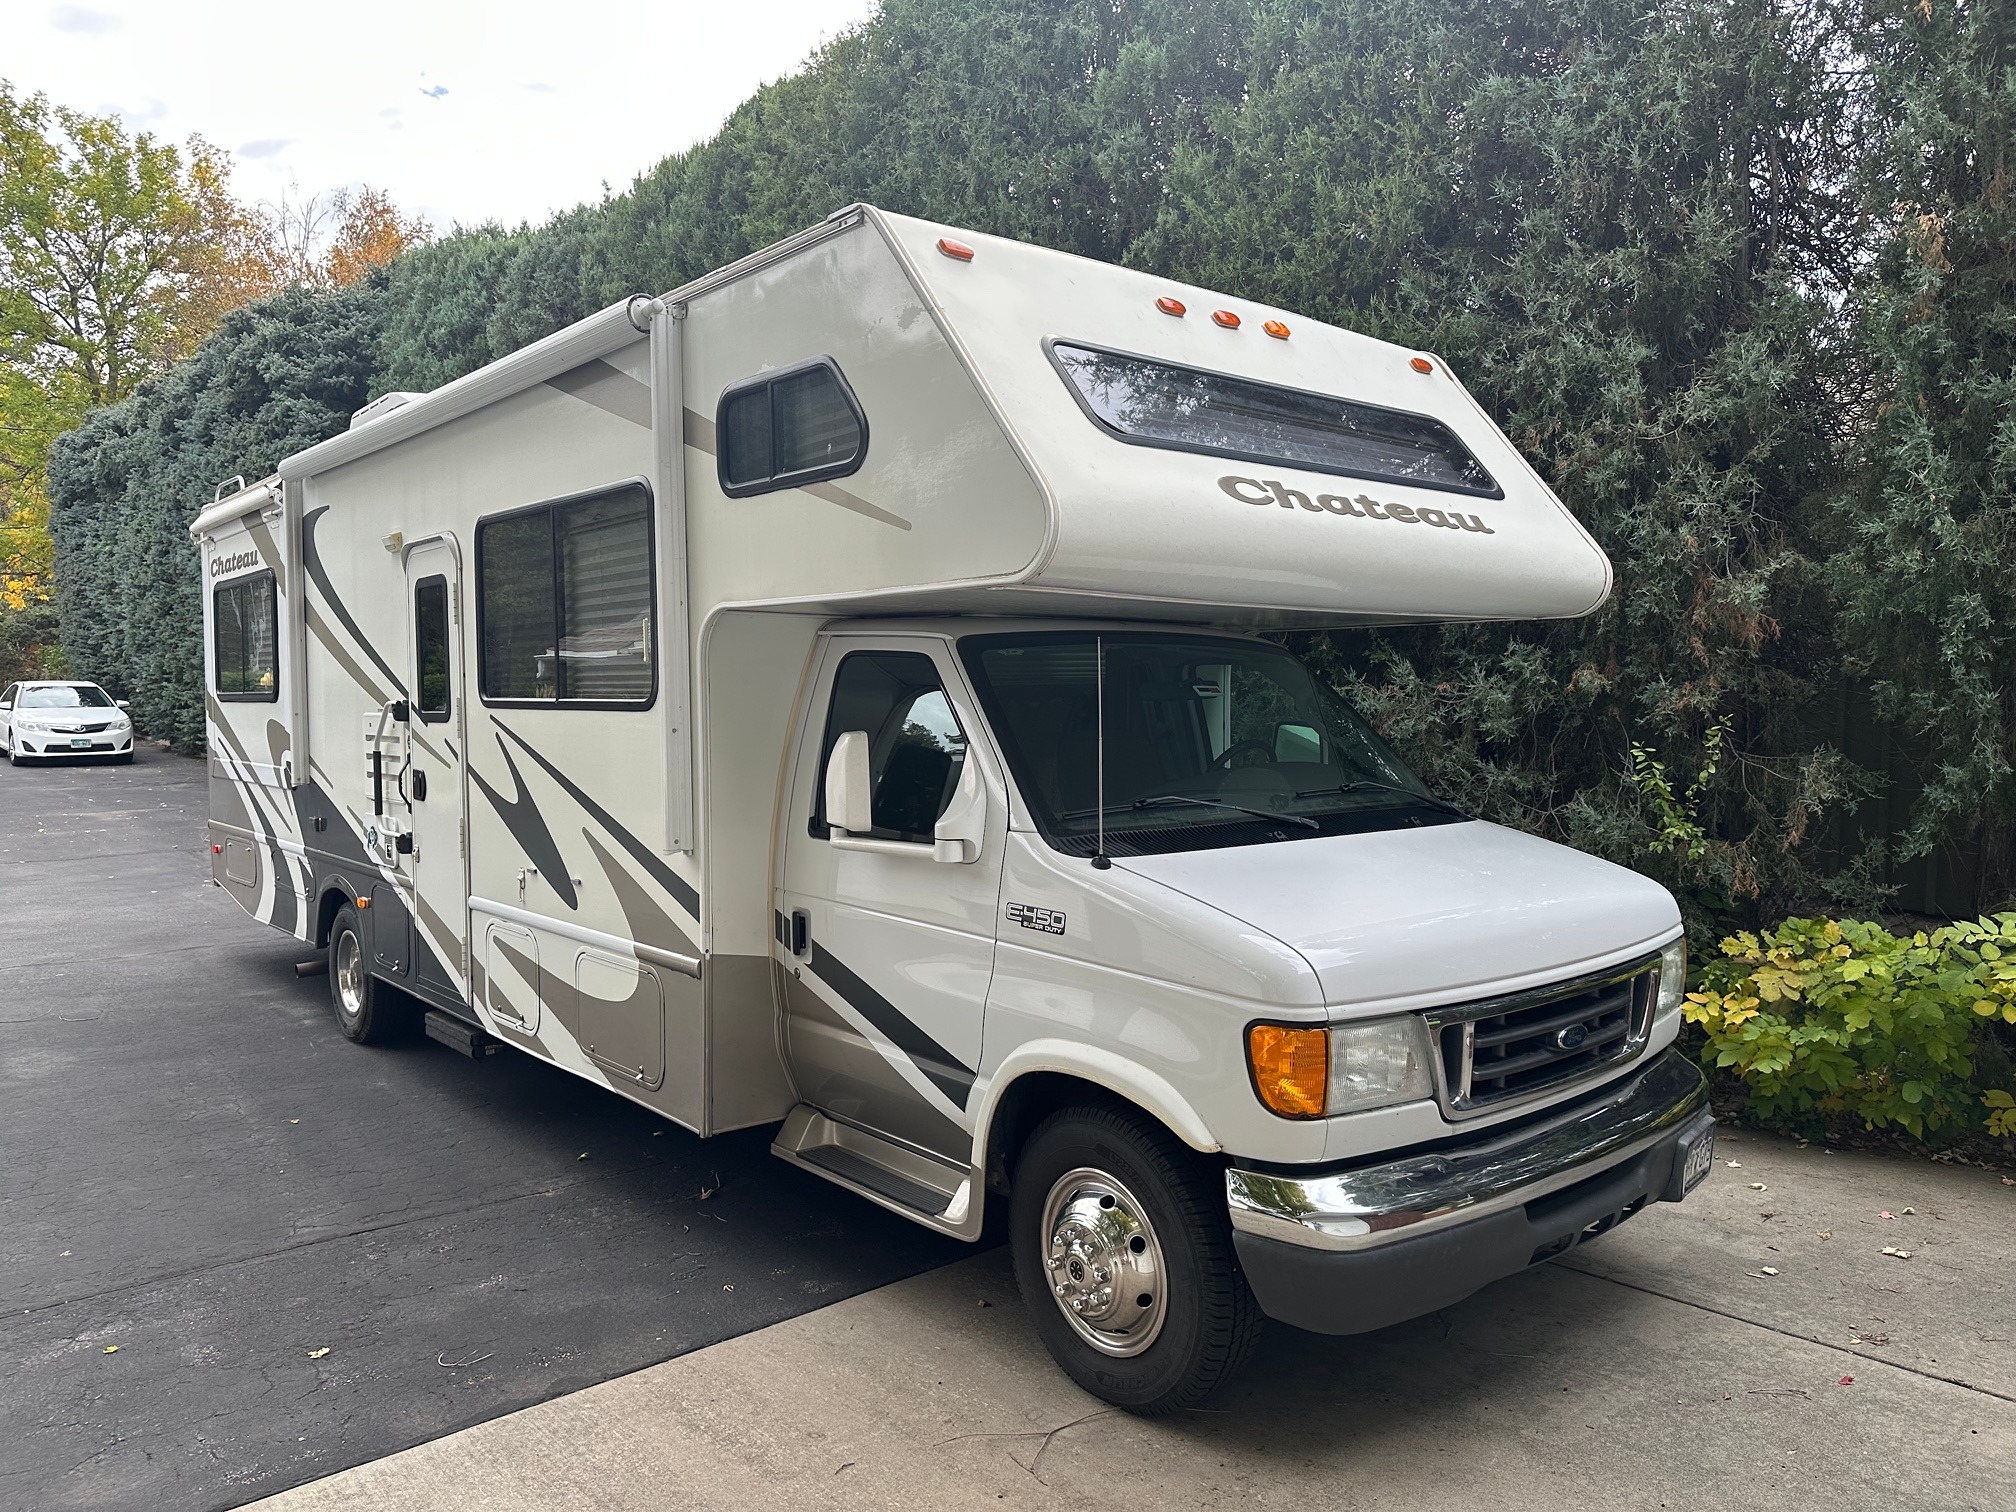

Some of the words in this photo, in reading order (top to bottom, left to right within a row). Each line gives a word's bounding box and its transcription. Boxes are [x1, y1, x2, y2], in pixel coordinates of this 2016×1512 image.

[1217, 475, 1495, 534] Chateau
[210, 550, 259, 578] Chateau
[1022, 921, 1043, 931] SUPER
[1044, 925, 1062, 934] DUTY
